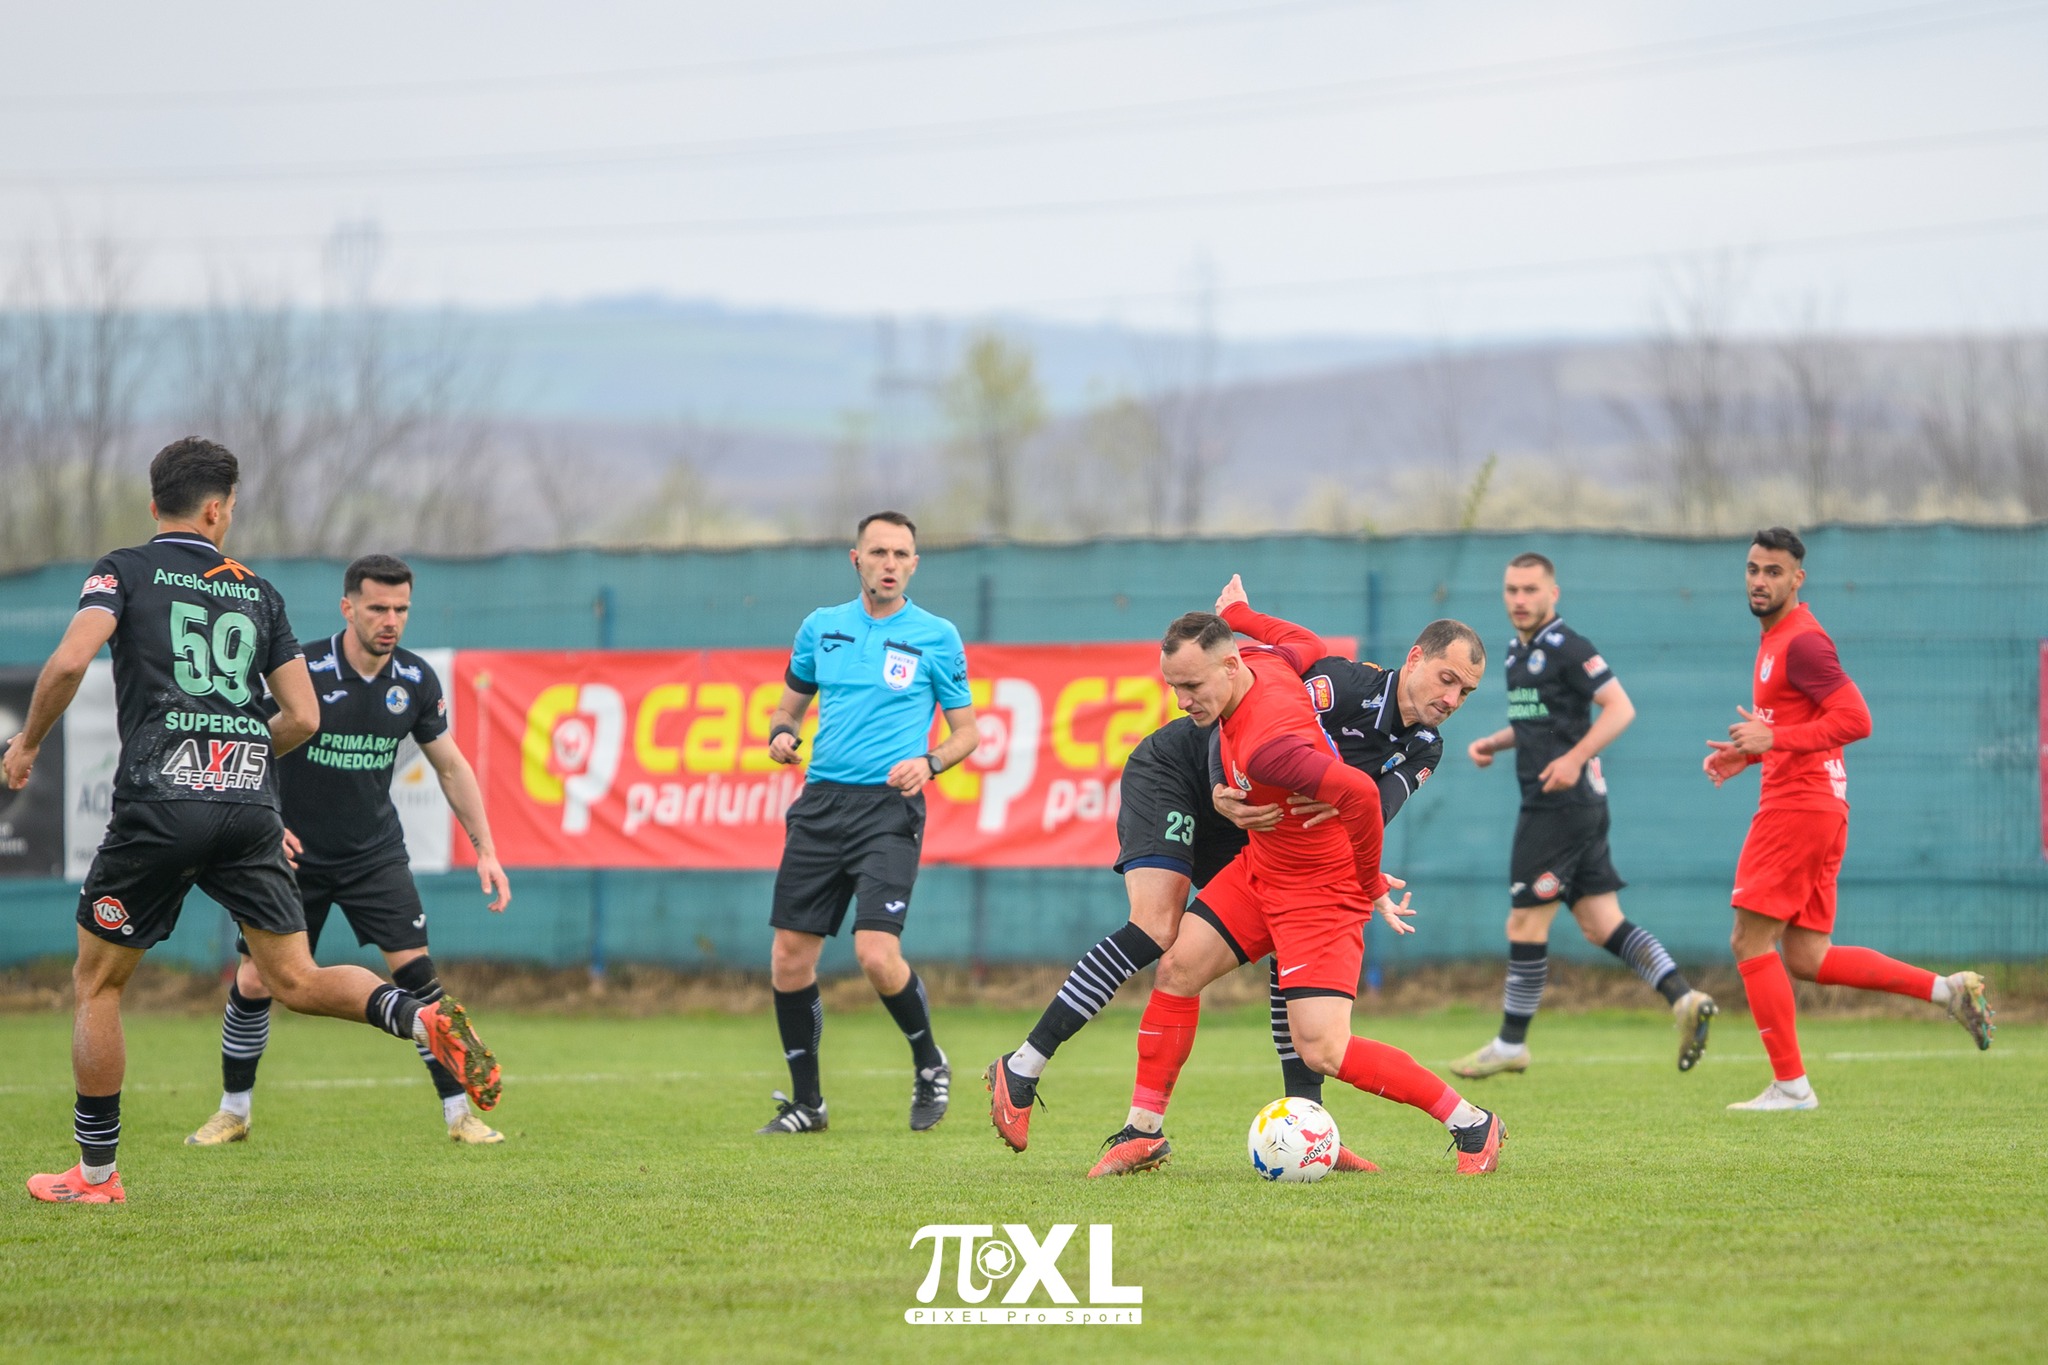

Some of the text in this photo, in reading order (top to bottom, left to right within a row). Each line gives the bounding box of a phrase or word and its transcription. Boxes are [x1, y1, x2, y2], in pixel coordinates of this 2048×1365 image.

[153, 568, 260, 601] ArcelorMitta
[170, 600, 256, 707] 59
[161, 739, 268, 780] AXIS
[174, 770, 262, 791] SECURITY
[1165, 811, 1195, 846] 23
[1303, 1132, 1334, 1164] PONTICA
